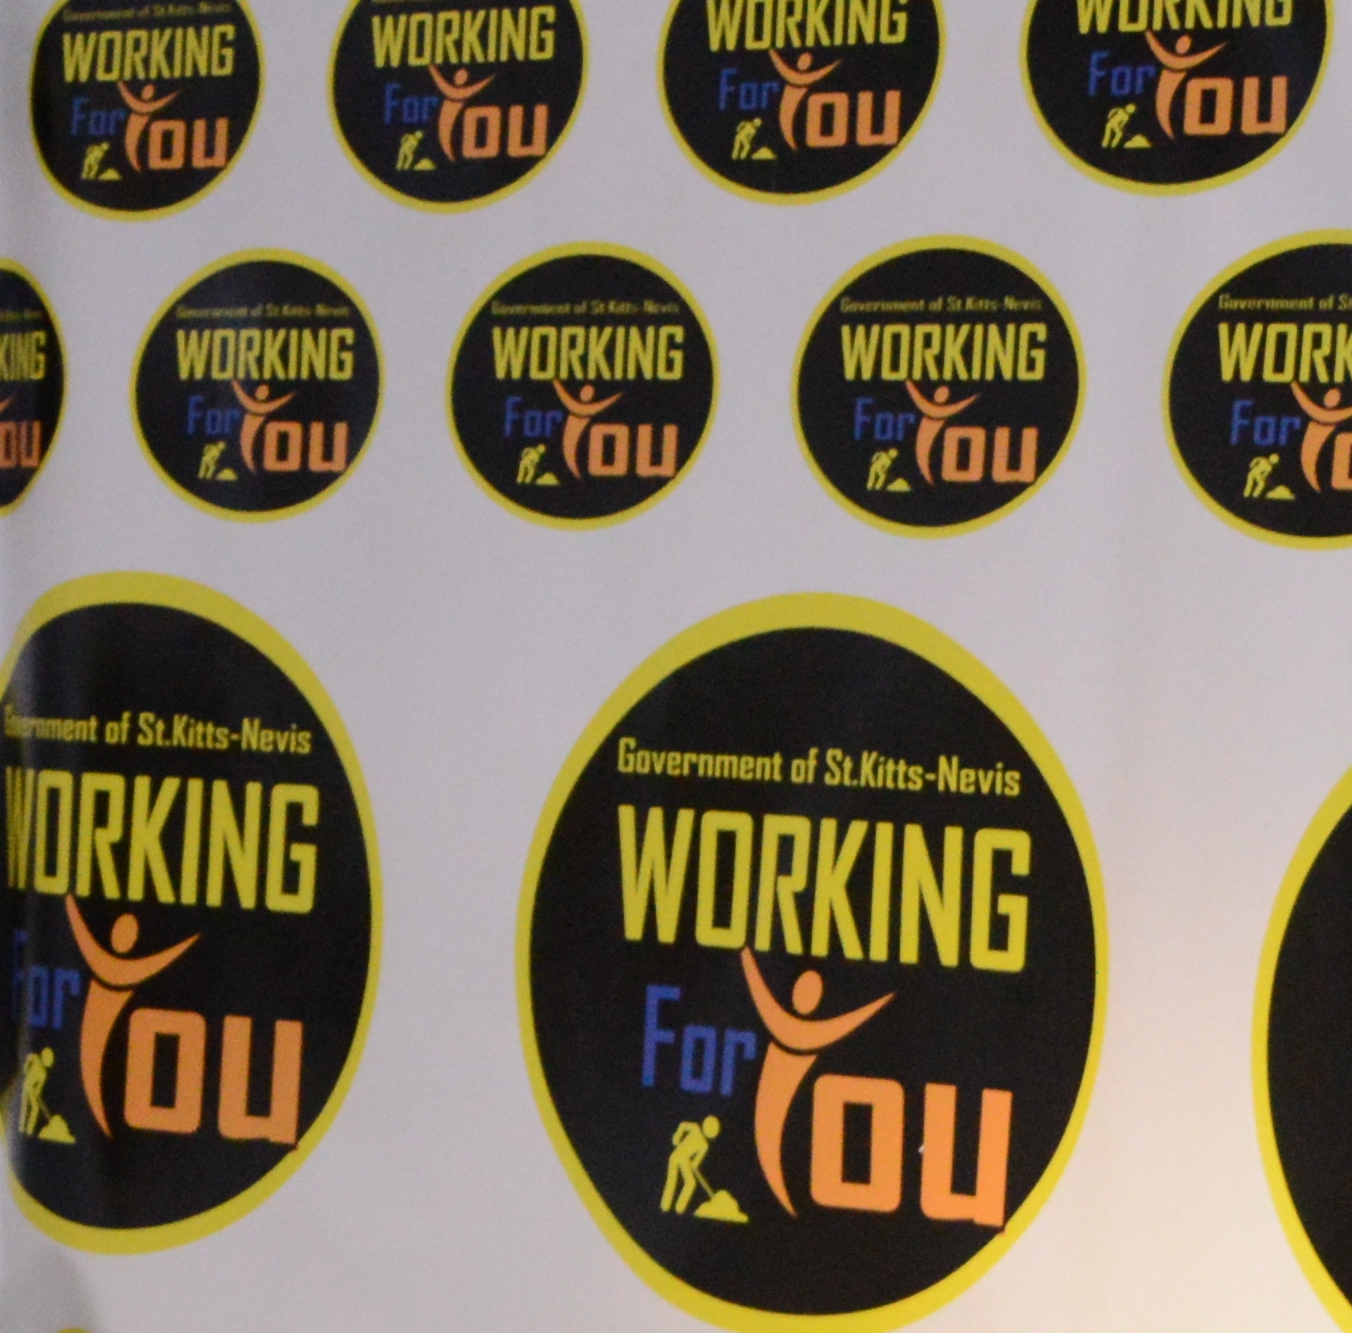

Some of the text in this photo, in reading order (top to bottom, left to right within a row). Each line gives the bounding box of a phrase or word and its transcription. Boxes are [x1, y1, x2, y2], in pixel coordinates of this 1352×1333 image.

[63, 24, 235, 84] WORKING
[371, 3, 556, 70] WORKING
[175, 327, 354, 382] WORKING
[492, 325, 684, 382] WORKING
[841, 322, 1047, 382] WORKING
[185, 394, 243, 435] For
[503, 395, 565, 437] For
[852, 397, 918, 441] For
[1230, 398, 1305, 446] For
[108, 711, 132, 745] of
[616, 740, 781, 783] Government
[788, 747, 815, 784] of
[4, 766, 320, 913] WORKING
[615, 806, 1029, 973] WORKING
[634, 984, 763, 1096] For
